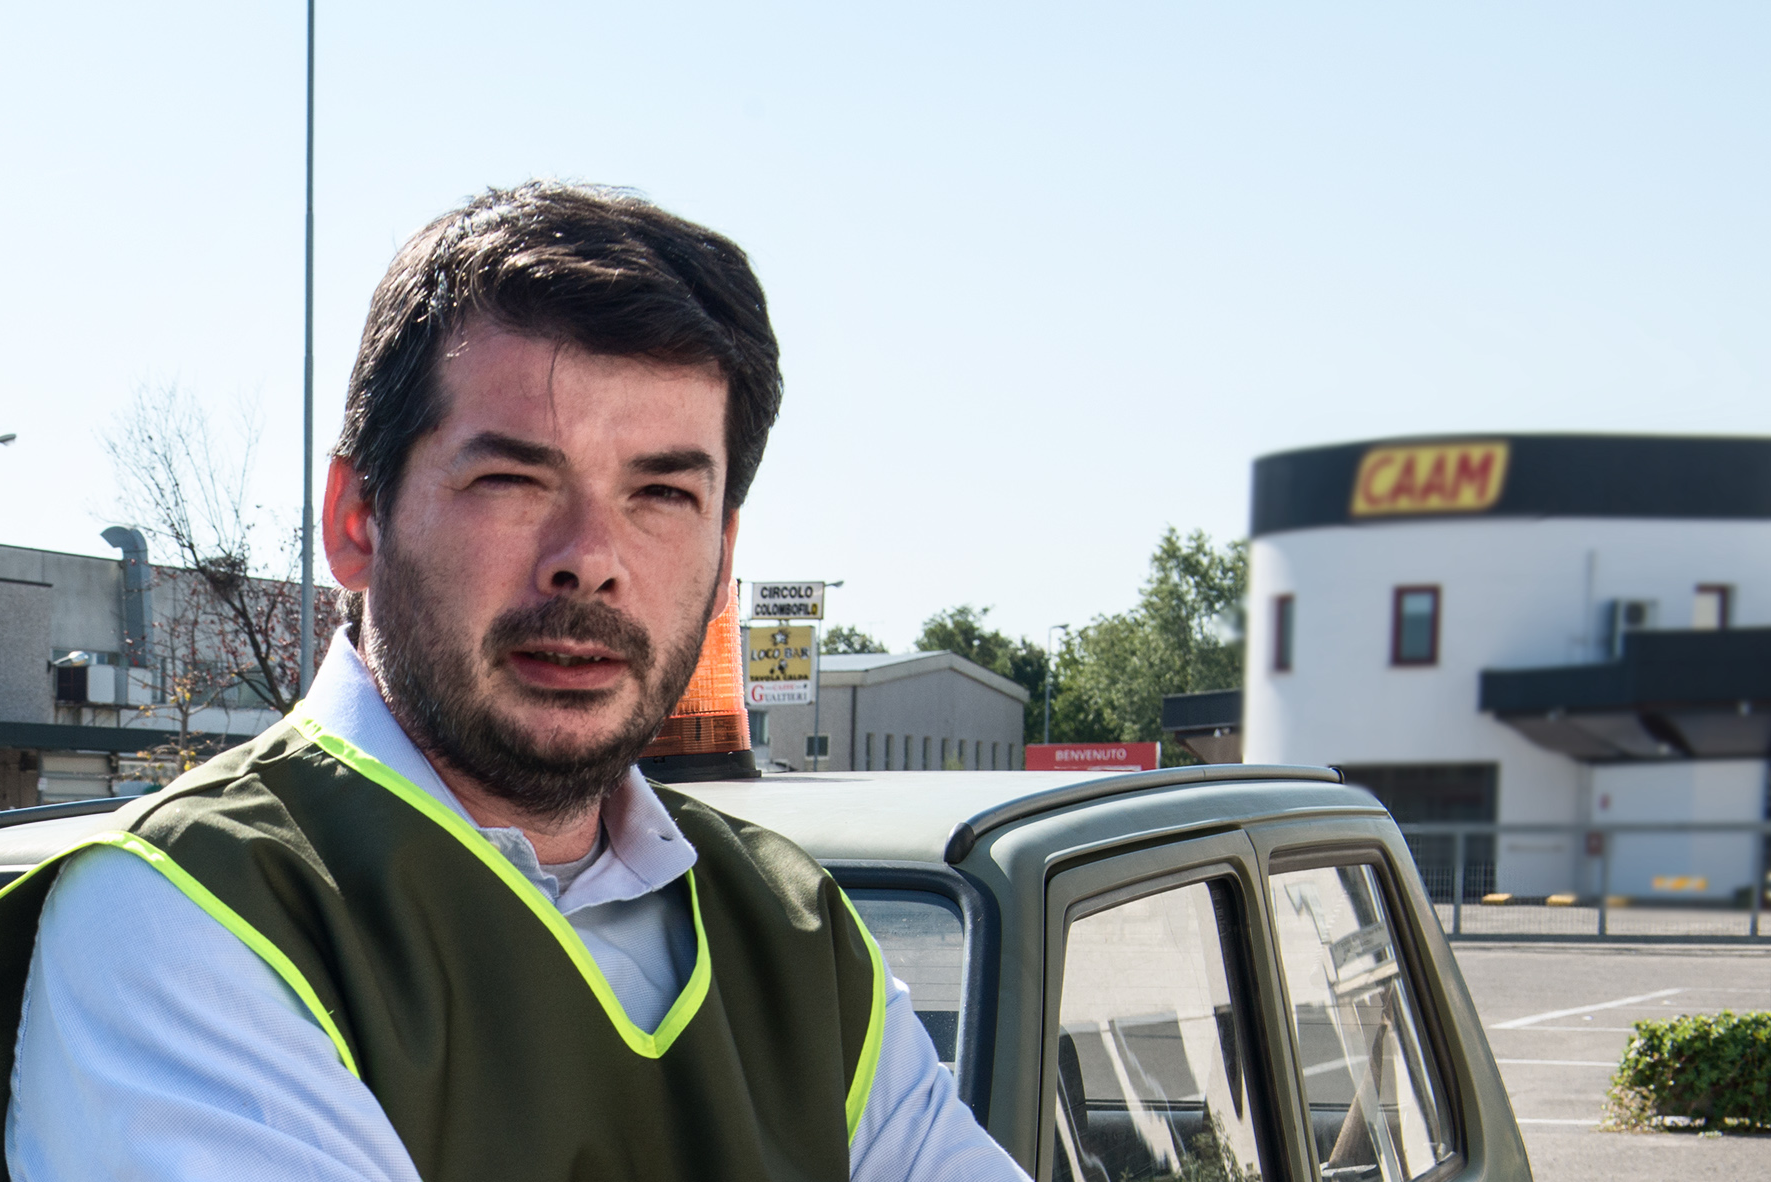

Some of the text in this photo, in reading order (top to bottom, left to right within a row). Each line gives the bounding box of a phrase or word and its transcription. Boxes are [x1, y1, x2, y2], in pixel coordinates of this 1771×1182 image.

[1361, 451, 1495, 508] CAAM
[760, 586, 814, 599] CIRCOLO
[754, 603, 818, 616] COLOMBOFILO
[751, 647, 810, 661] LOCO BAR
[1055, 748, 1127, 761] BENVENUTO
